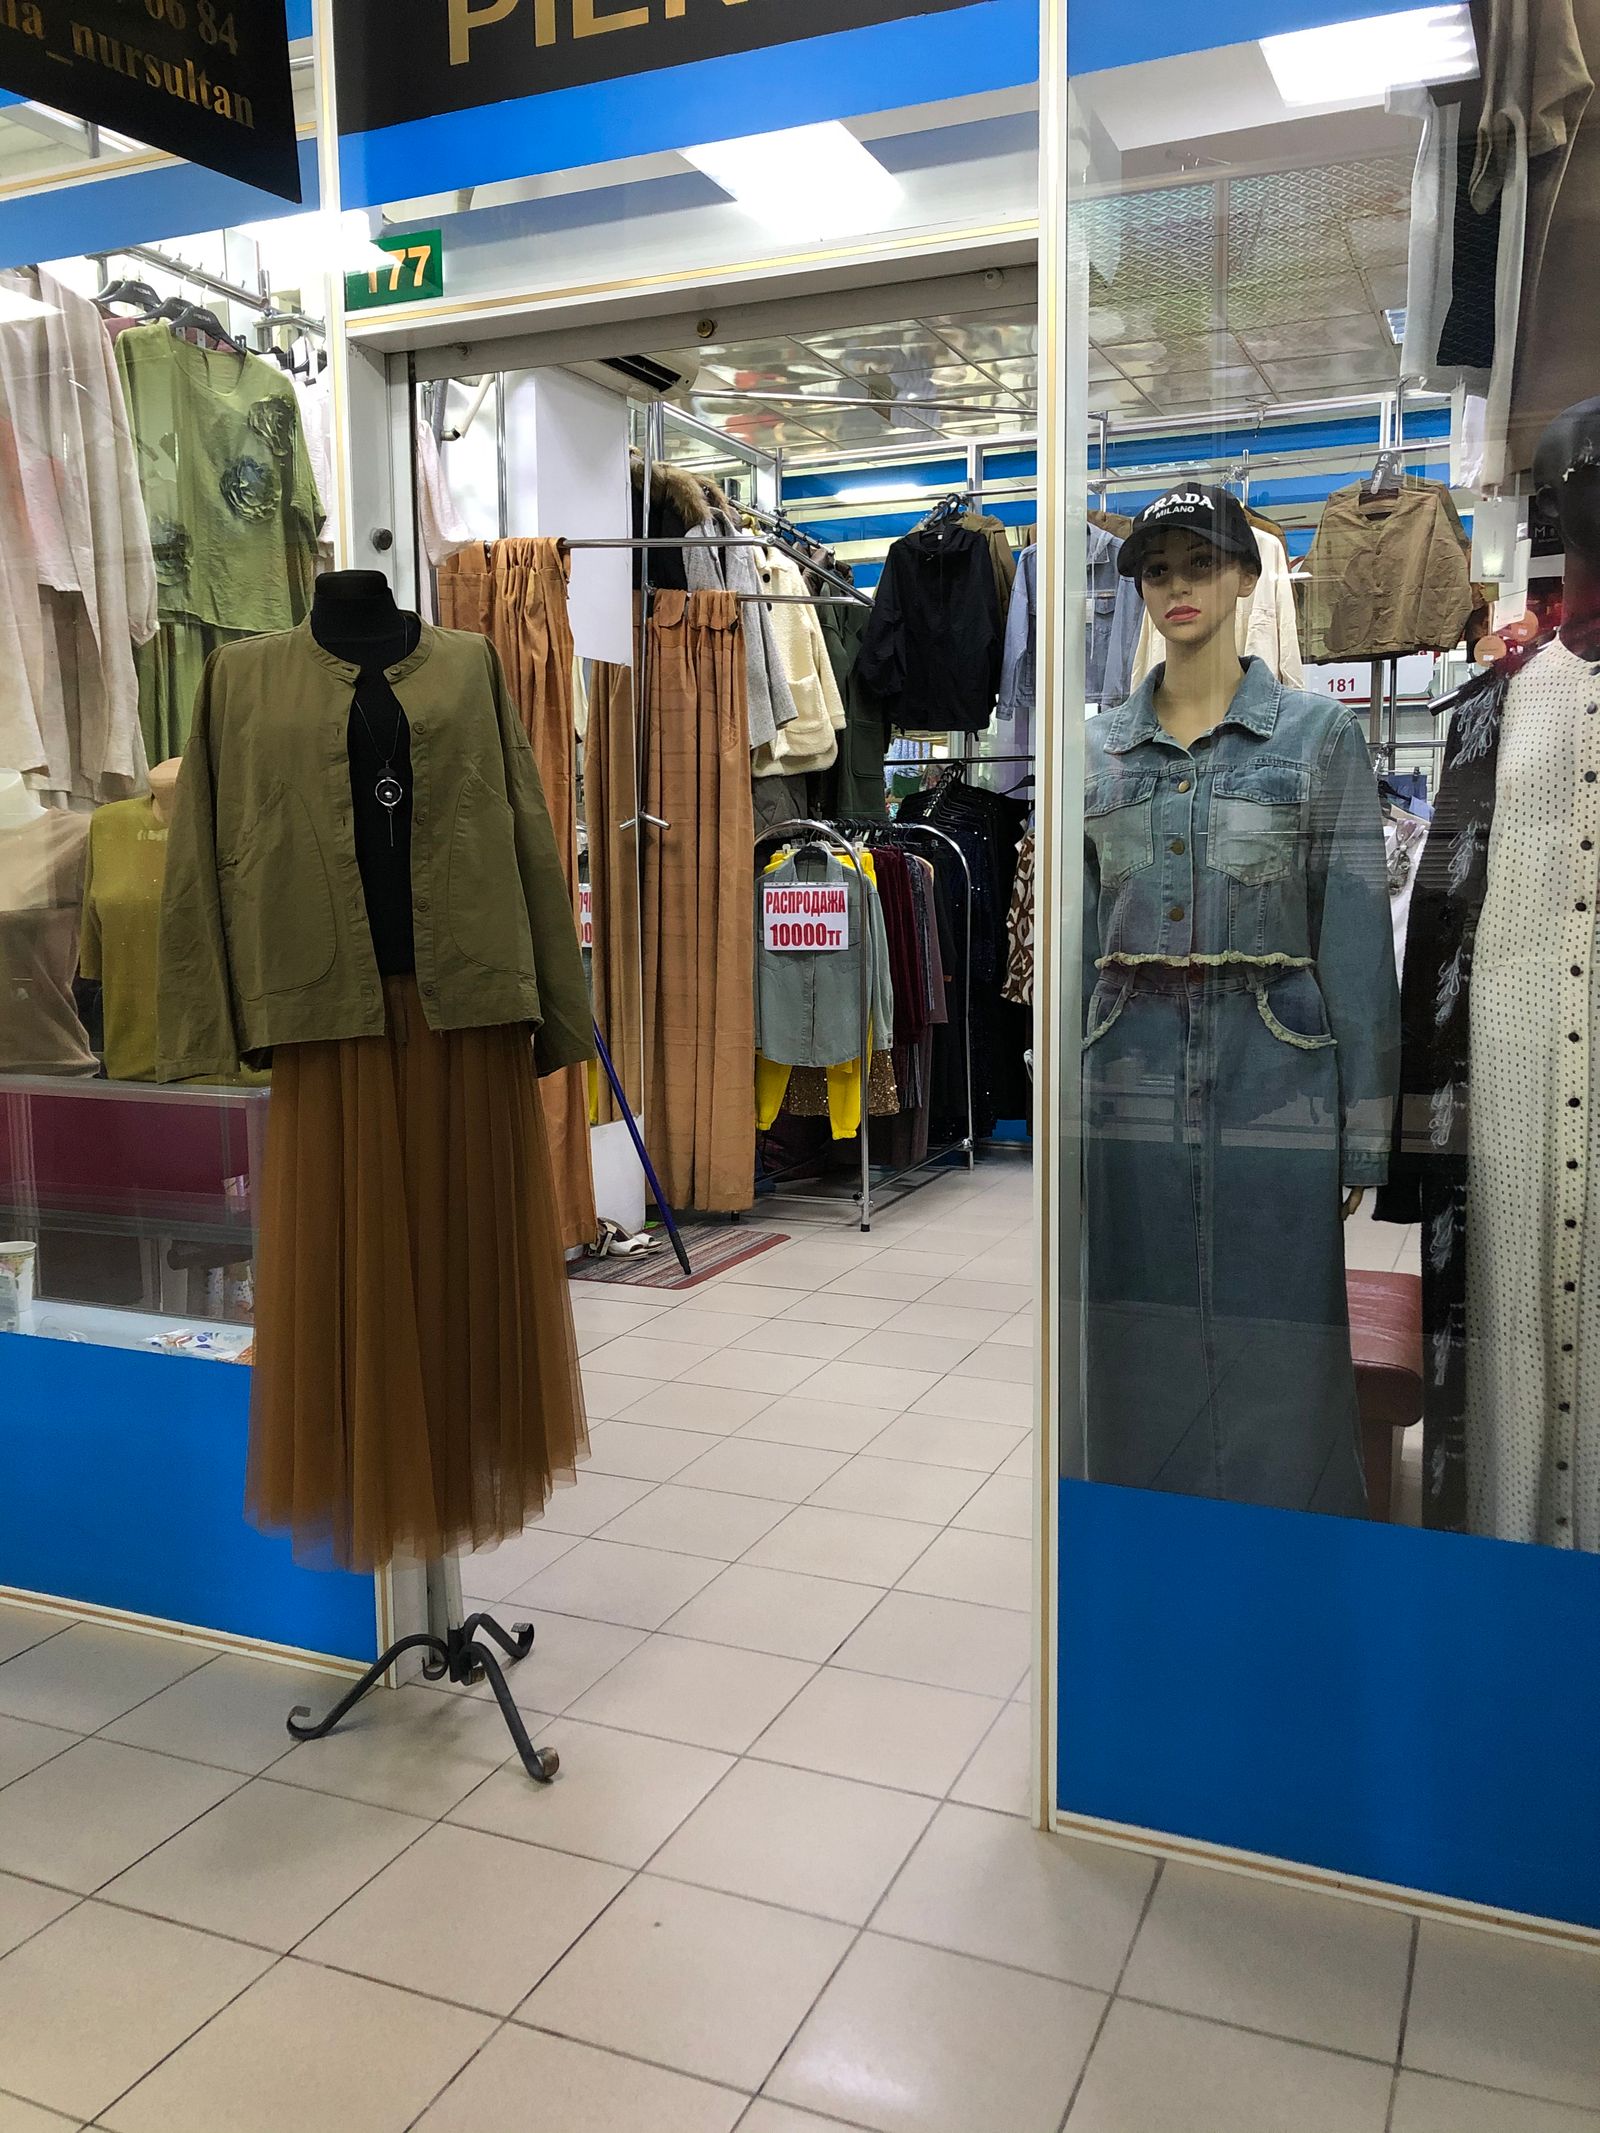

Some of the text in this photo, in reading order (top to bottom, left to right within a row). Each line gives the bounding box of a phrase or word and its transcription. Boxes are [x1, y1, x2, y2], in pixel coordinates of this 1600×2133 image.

[197, 2, 238, 56] 84
[1142, 492, 1215, 522] PRADA
[1155, 505, 1195, 519] MILANO
[1327, 678, 1356, 693] 181
[765, 890, 846, 917] РАСПРОДАЖА
